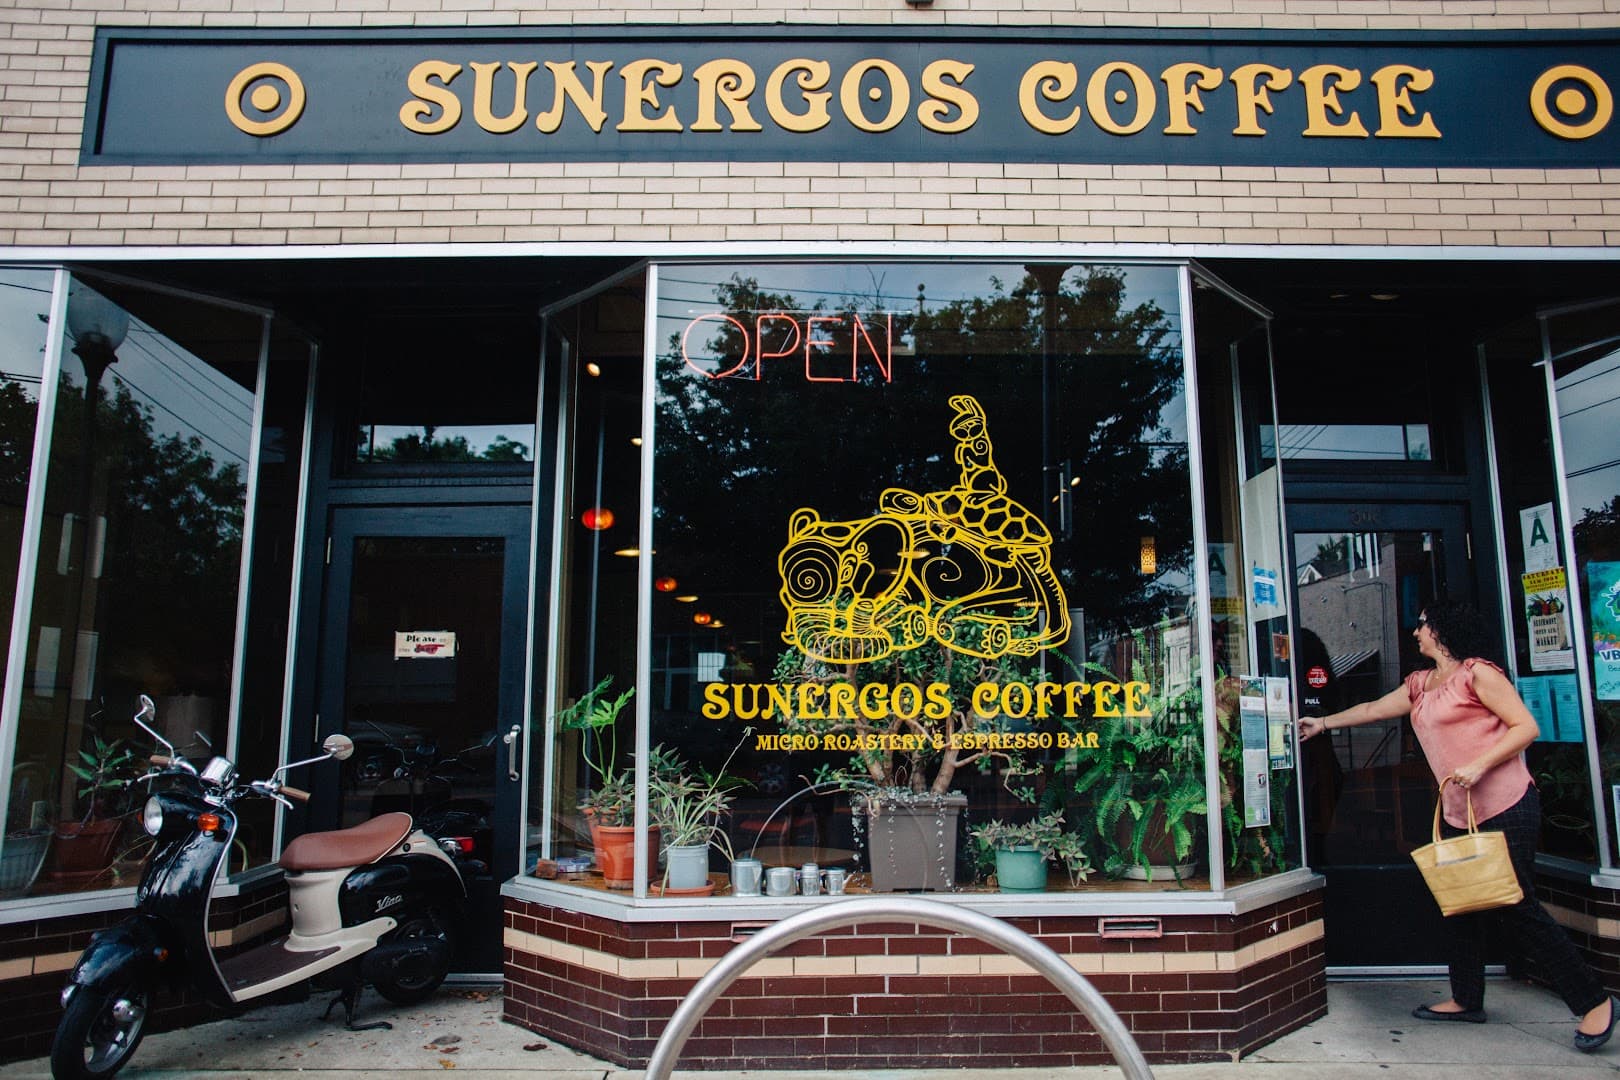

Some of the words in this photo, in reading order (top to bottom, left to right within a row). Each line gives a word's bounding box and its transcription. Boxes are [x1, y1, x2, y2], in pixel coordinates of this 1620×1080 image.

[399, 58, 980, 134] SUNERGOS
[1018, 60, 1442, 138] COFFEE
[682, 312, 892, 383] OPEN
[1530, 518, 1549, 546] A
[406, 634, 437, 643] Please
[701, 681, 953, 721] SUNERGOS
[971, 680, 1152, 720] COFFEE
[932, 730, 945, 752] &
[950, 732, 1053, 751] ESPRESSO
[1057, 732, 1101, 750] BAR
[375, 894, 403, 913] Vino
